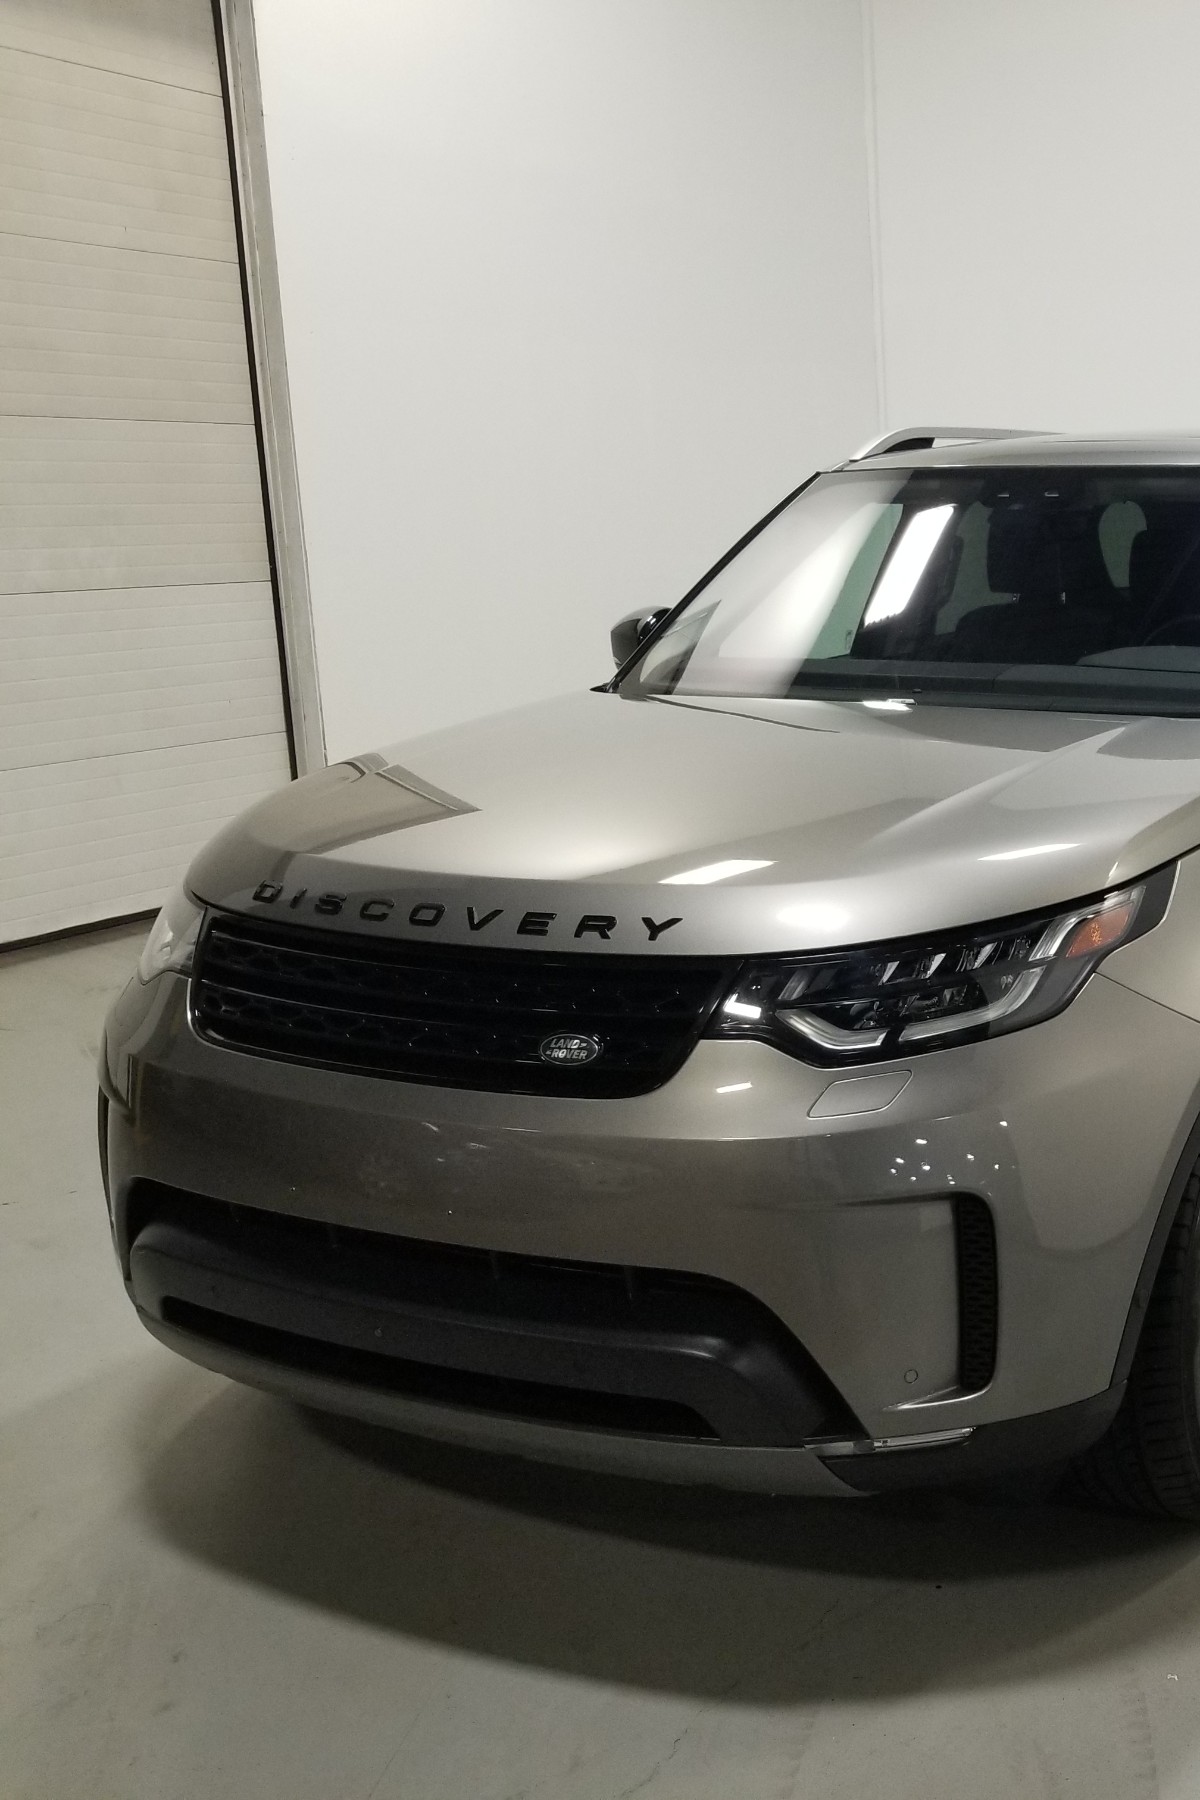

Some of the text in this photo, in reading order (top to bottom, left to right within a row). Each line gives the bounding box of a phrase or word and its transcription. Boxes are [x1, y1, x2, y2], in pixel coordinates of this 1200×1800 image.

[252, 880, 682, 941] DISCOVERY
[550, 1038, 580, 1049] LAND
[550, 1048, 588, 1060] ROVER
